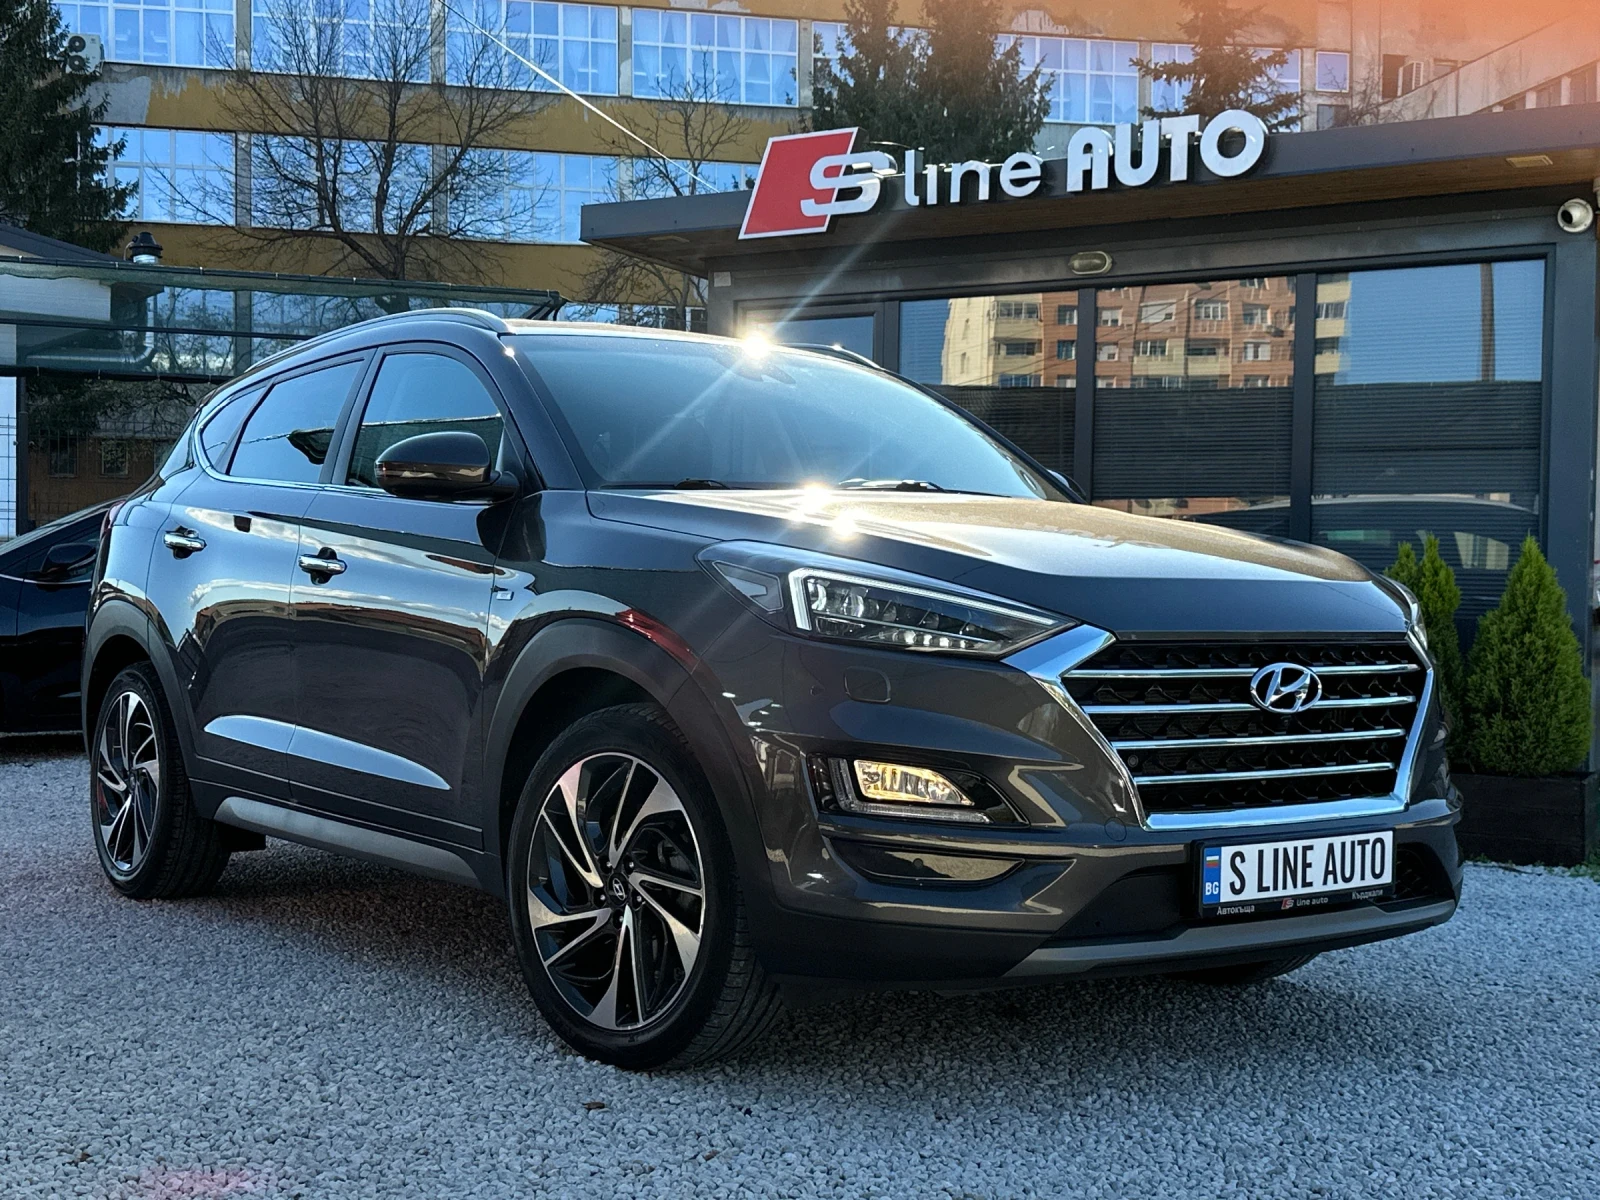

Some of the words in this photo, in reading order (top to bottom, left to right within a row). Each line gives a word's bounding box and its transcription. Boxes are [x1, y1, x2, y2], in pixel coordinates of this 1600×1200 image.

[800, 150, 895, 217] S
[904, 148, 1042, 207] line
[1066, 109, 1268, 193] AUTO
[1229, 850, 1246, 896] S
[1257, 844, 1315, 894] LINE
[1322, 837, 1387, 886] AUTO
[1205, 881, 1220, 896] BG
[1311, 897, 1329, 905] auto
